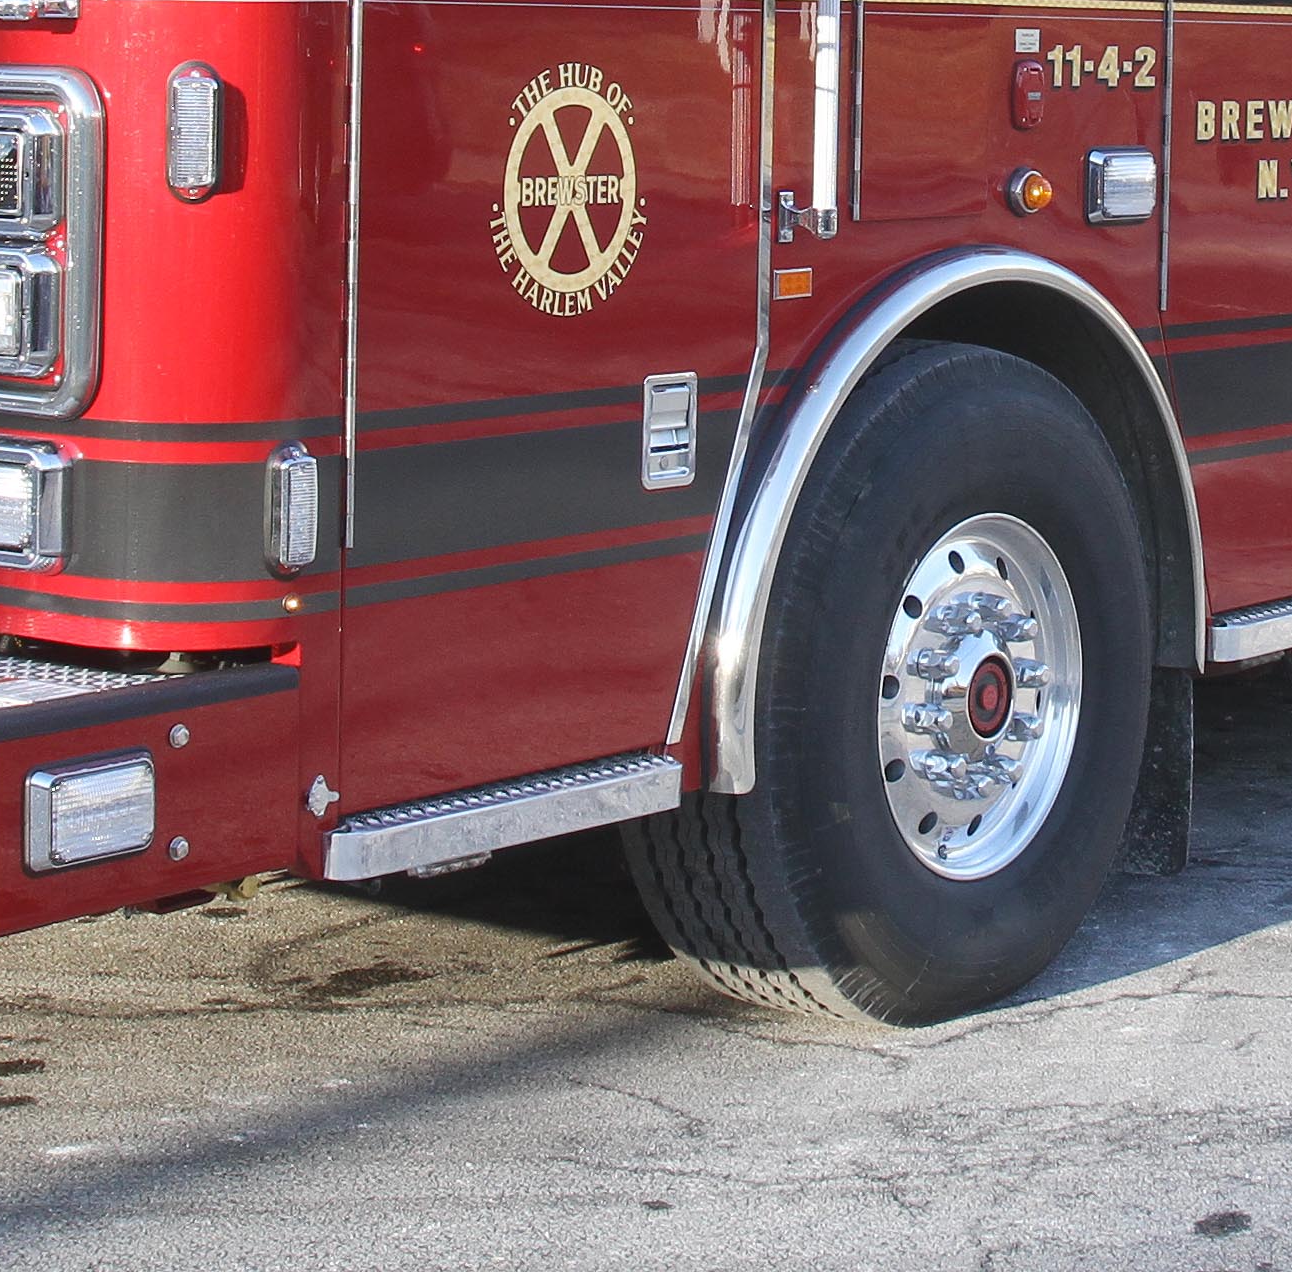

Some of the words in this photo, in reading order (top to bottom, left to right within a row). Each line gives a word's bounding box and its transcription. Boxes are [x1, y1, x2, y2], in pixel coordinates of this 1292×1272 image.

[511, 69, 554, 118] THE
[557, 62, 604, 92] HUB
[606, 82, 634, 116] OF
[520, 175, 621, 208] BREWSTER
[489, 211, 519, 273] THE
[511, 270, 594, 318] HARLEM
[593, 208, 648, 302] VALLEY
